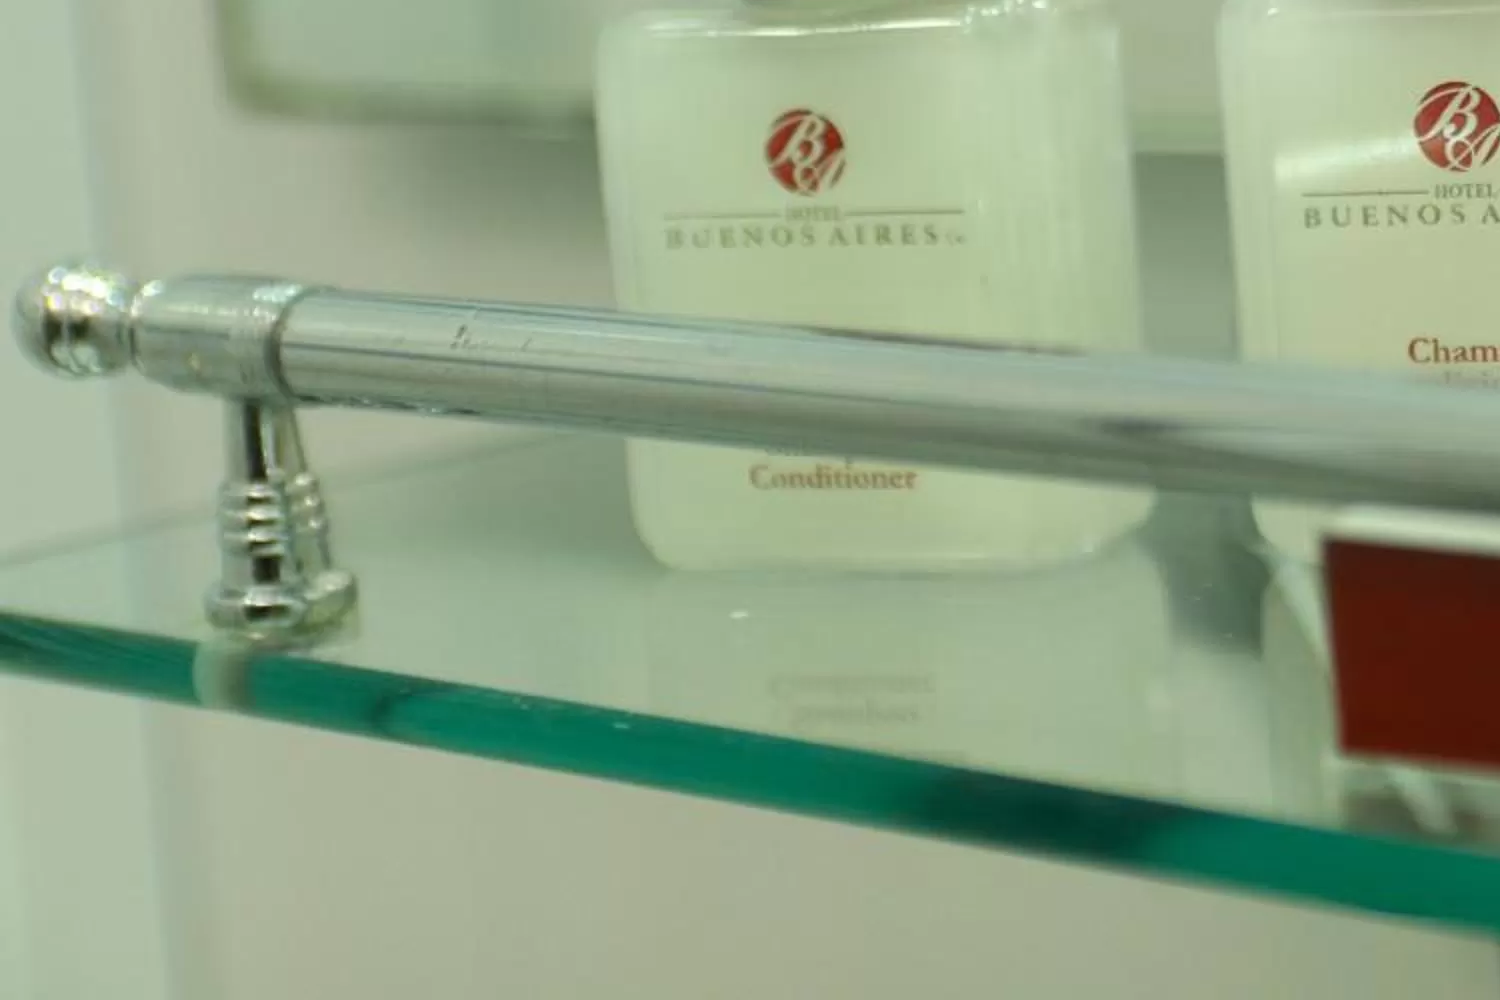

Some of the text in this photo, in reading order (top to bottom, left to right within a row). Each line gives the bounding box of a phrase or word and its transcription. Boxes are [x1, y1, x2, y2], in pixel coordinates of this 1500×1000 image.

[1434, 183, 1496, 200] HOTEL
[1303, 202, 1468, 229] BUENOS
[663, 223, 818, 249] BUENOS
[827, 222, 939, 247] AIRES
[748, 462, 918, 490] Conditioner
